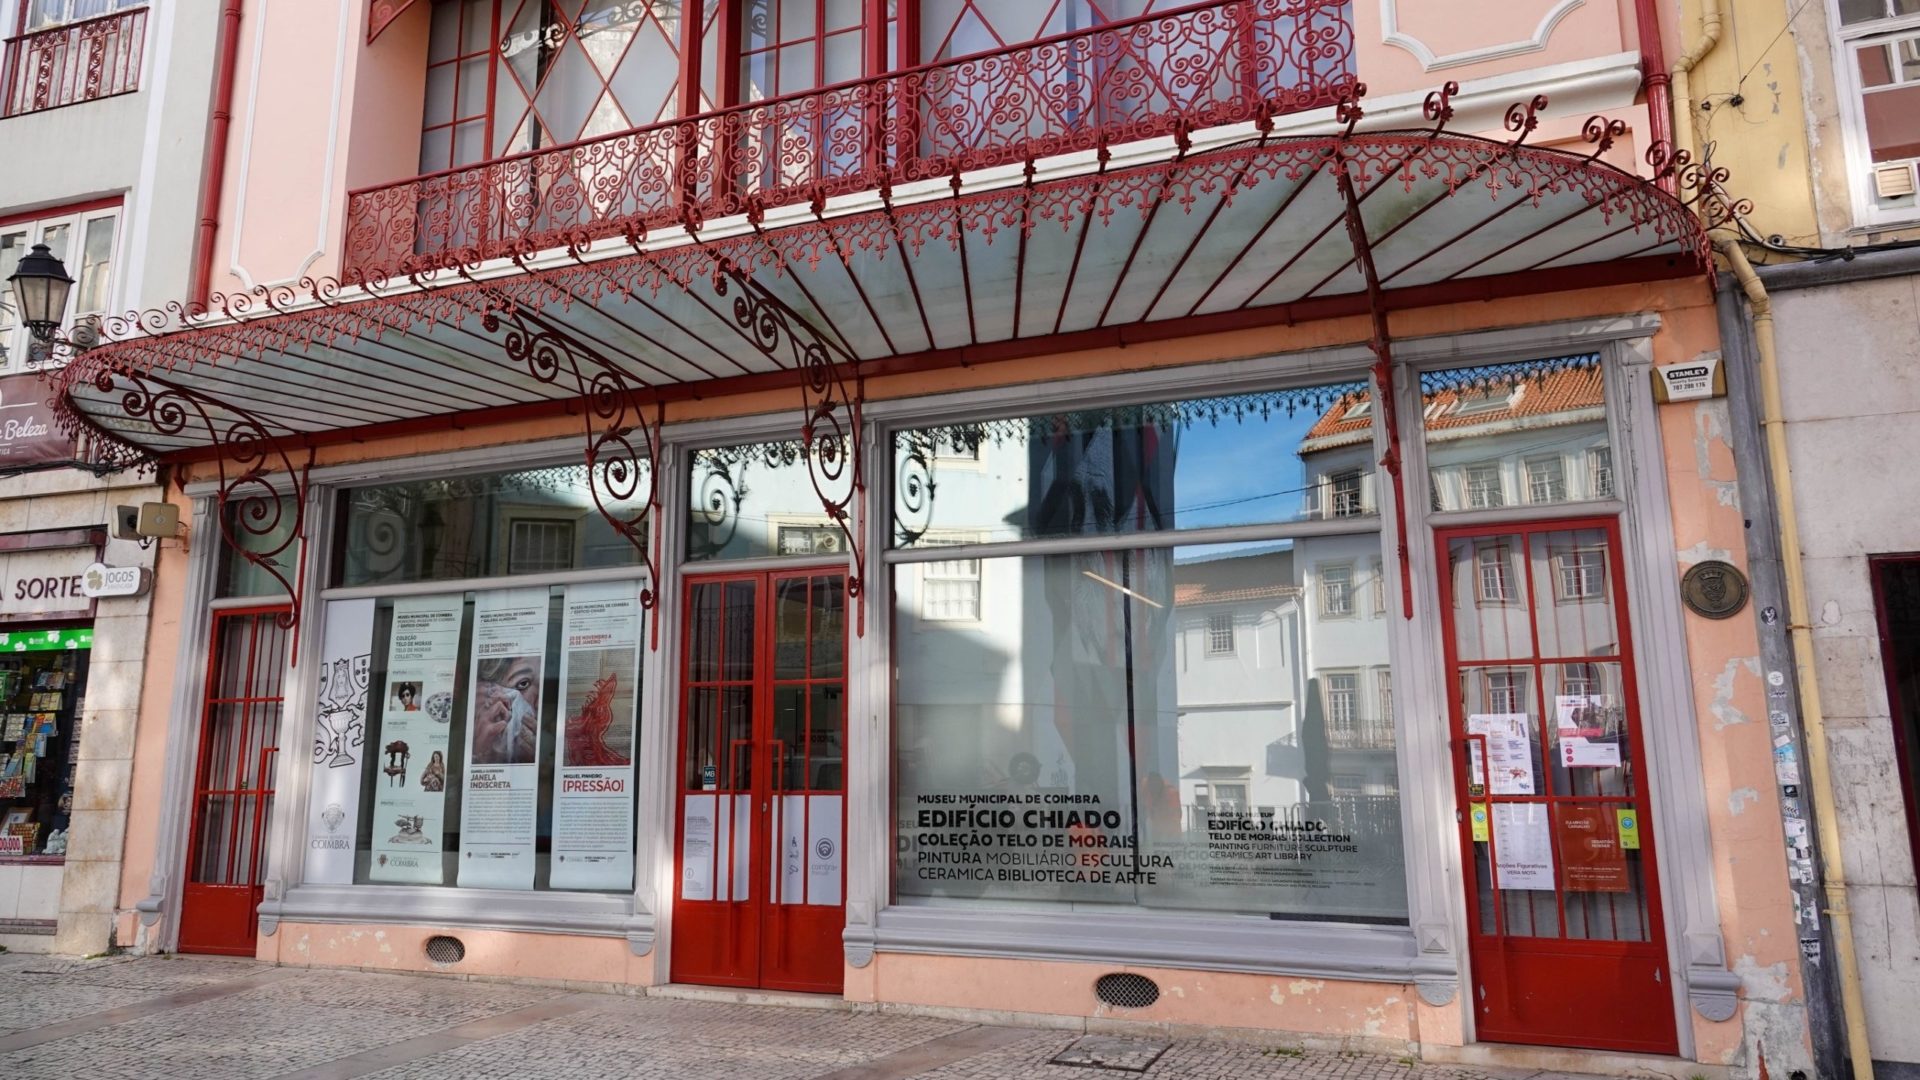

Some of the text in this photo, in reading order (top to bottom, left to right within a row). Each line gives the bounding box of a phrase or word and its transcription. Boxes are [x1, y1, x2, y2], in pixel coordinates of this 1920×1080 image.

[1670, 368, 1706, 378] STANLEY
[4, 416, 48, 440] Beleza
[105, 571, 134, 586] JOGOS
[15, 574, 87, 600] SORTE
[563, 777, 624, 792] [PRESSÃO]
[918, 795, 1100, 804] MUSEU MUNICIPAL DE COIMBRA
[918, 804, 1121, 829] EDIFÍCIO CHIADO
[311, 840, 350, 850] COIMBRA
[918, 830, 1137, 850] COLEÇÃO TELO DE MORAIS
[1249, 834, 1287, 842] MORAIS
[1252, 843, 1303, 852] FURNITURE
[918, 850, 1174, 868] PINTURA MOBILIÁRIO ESCULTURA
[918, 867, 1156, 884] CERAMICA BIBLIOTECA DE ARTE
